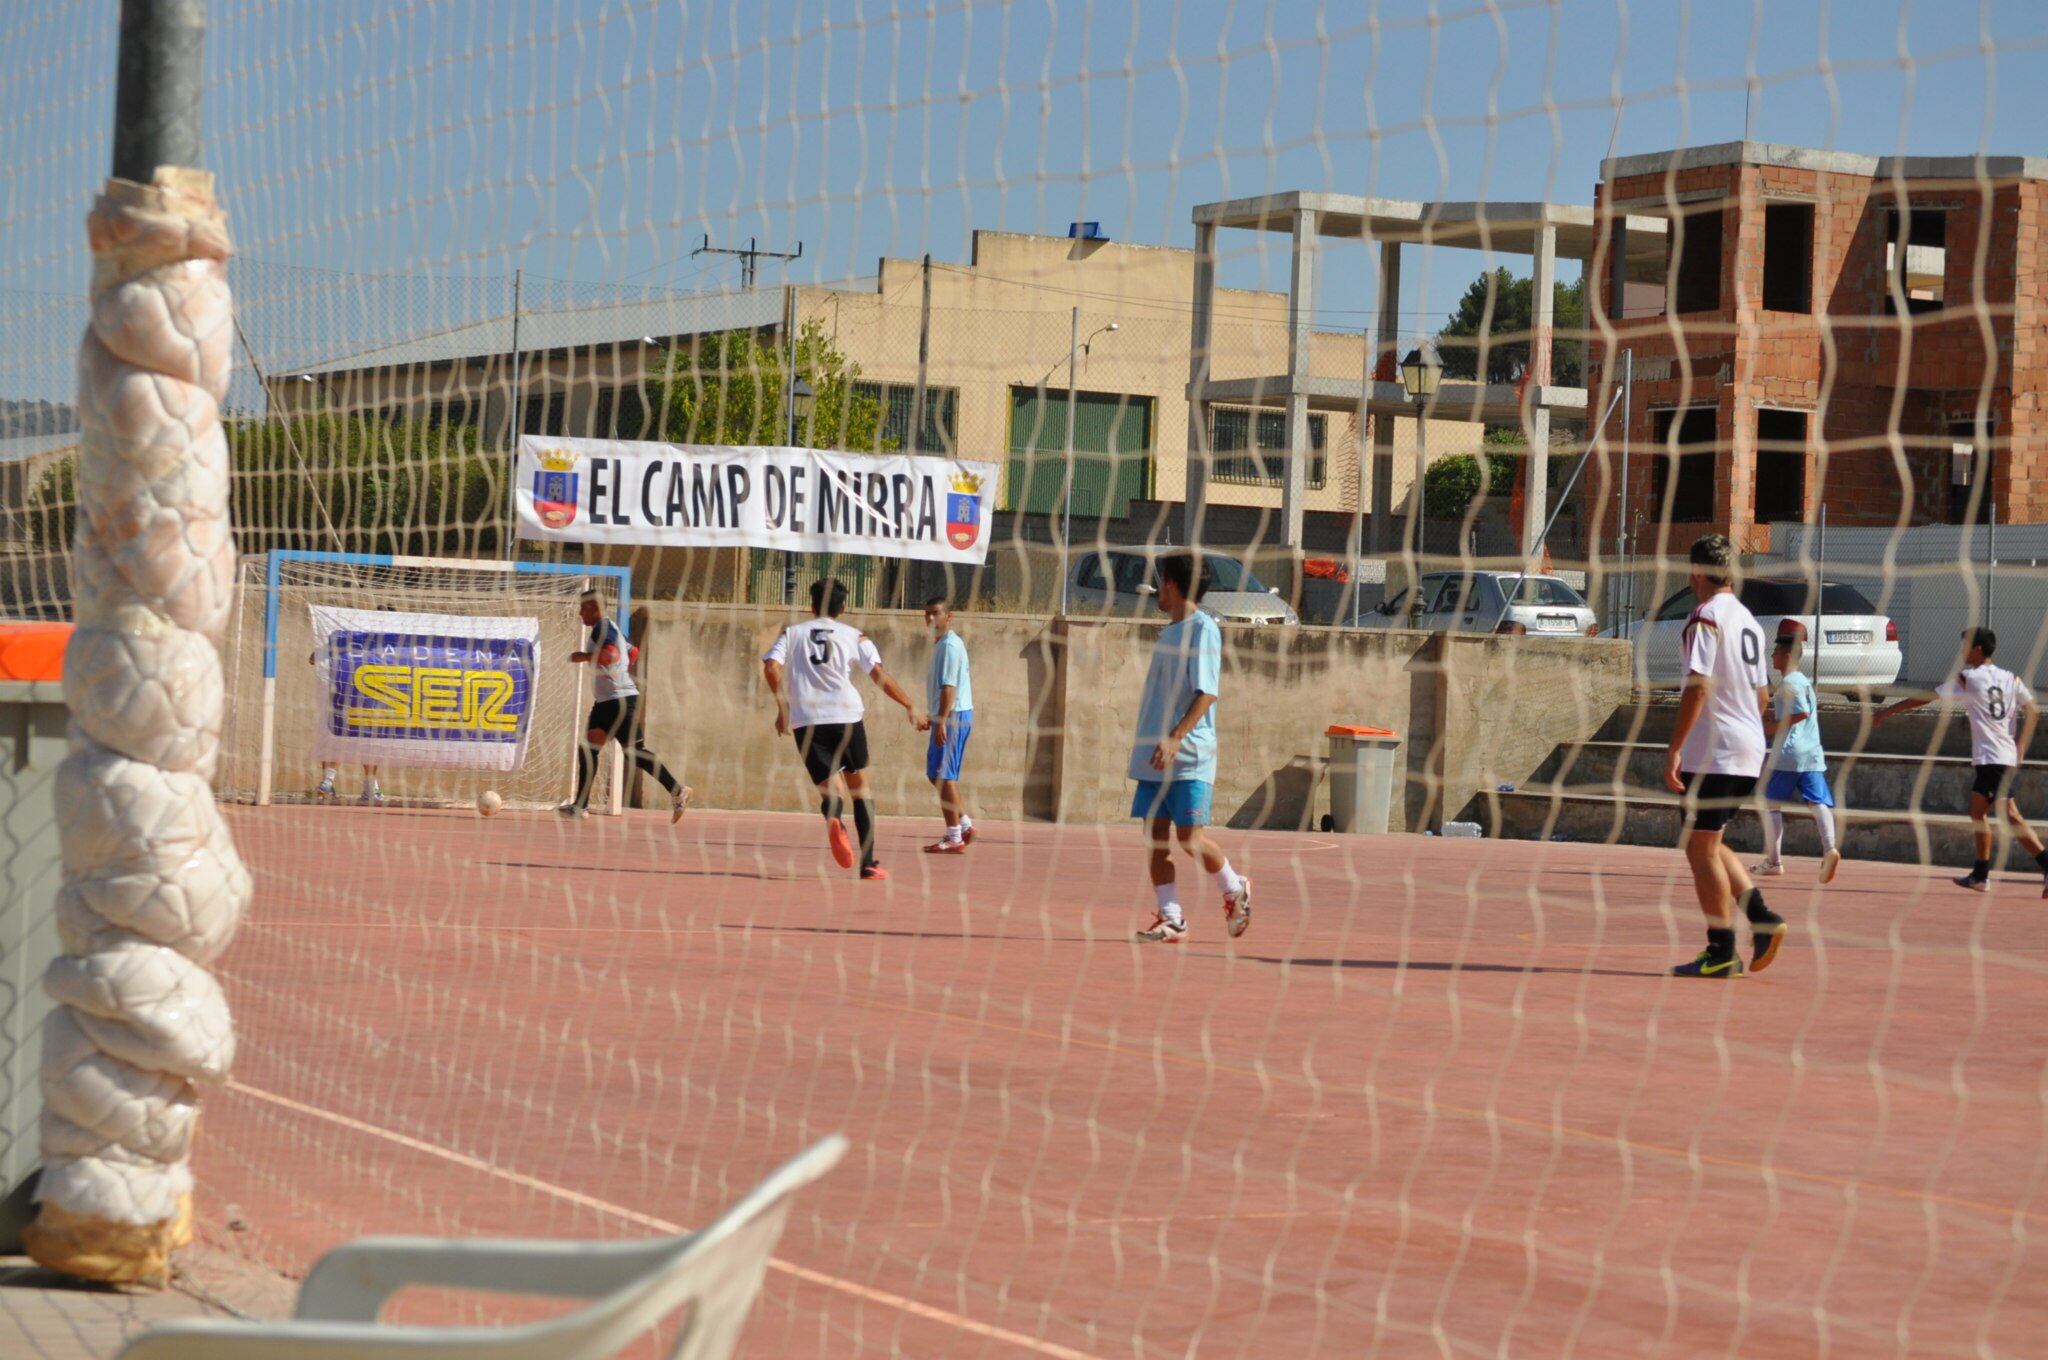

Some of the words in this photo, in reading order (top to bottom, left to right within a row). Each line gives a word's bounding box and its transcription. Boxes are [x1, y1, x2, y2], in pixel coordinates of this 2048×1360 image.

[589, 457, 631, 526] EL
[641, 459, 751, 528] CAMP
[764, 464, 806, 533] DE
[817, 466, 937, 542] MIRRA
[349, 642, 521, 664] CADENA
[809, 628, 834, 666] 5
[347, 664, 518, 732] SER
[1986, 685, 2006, 721] 8
